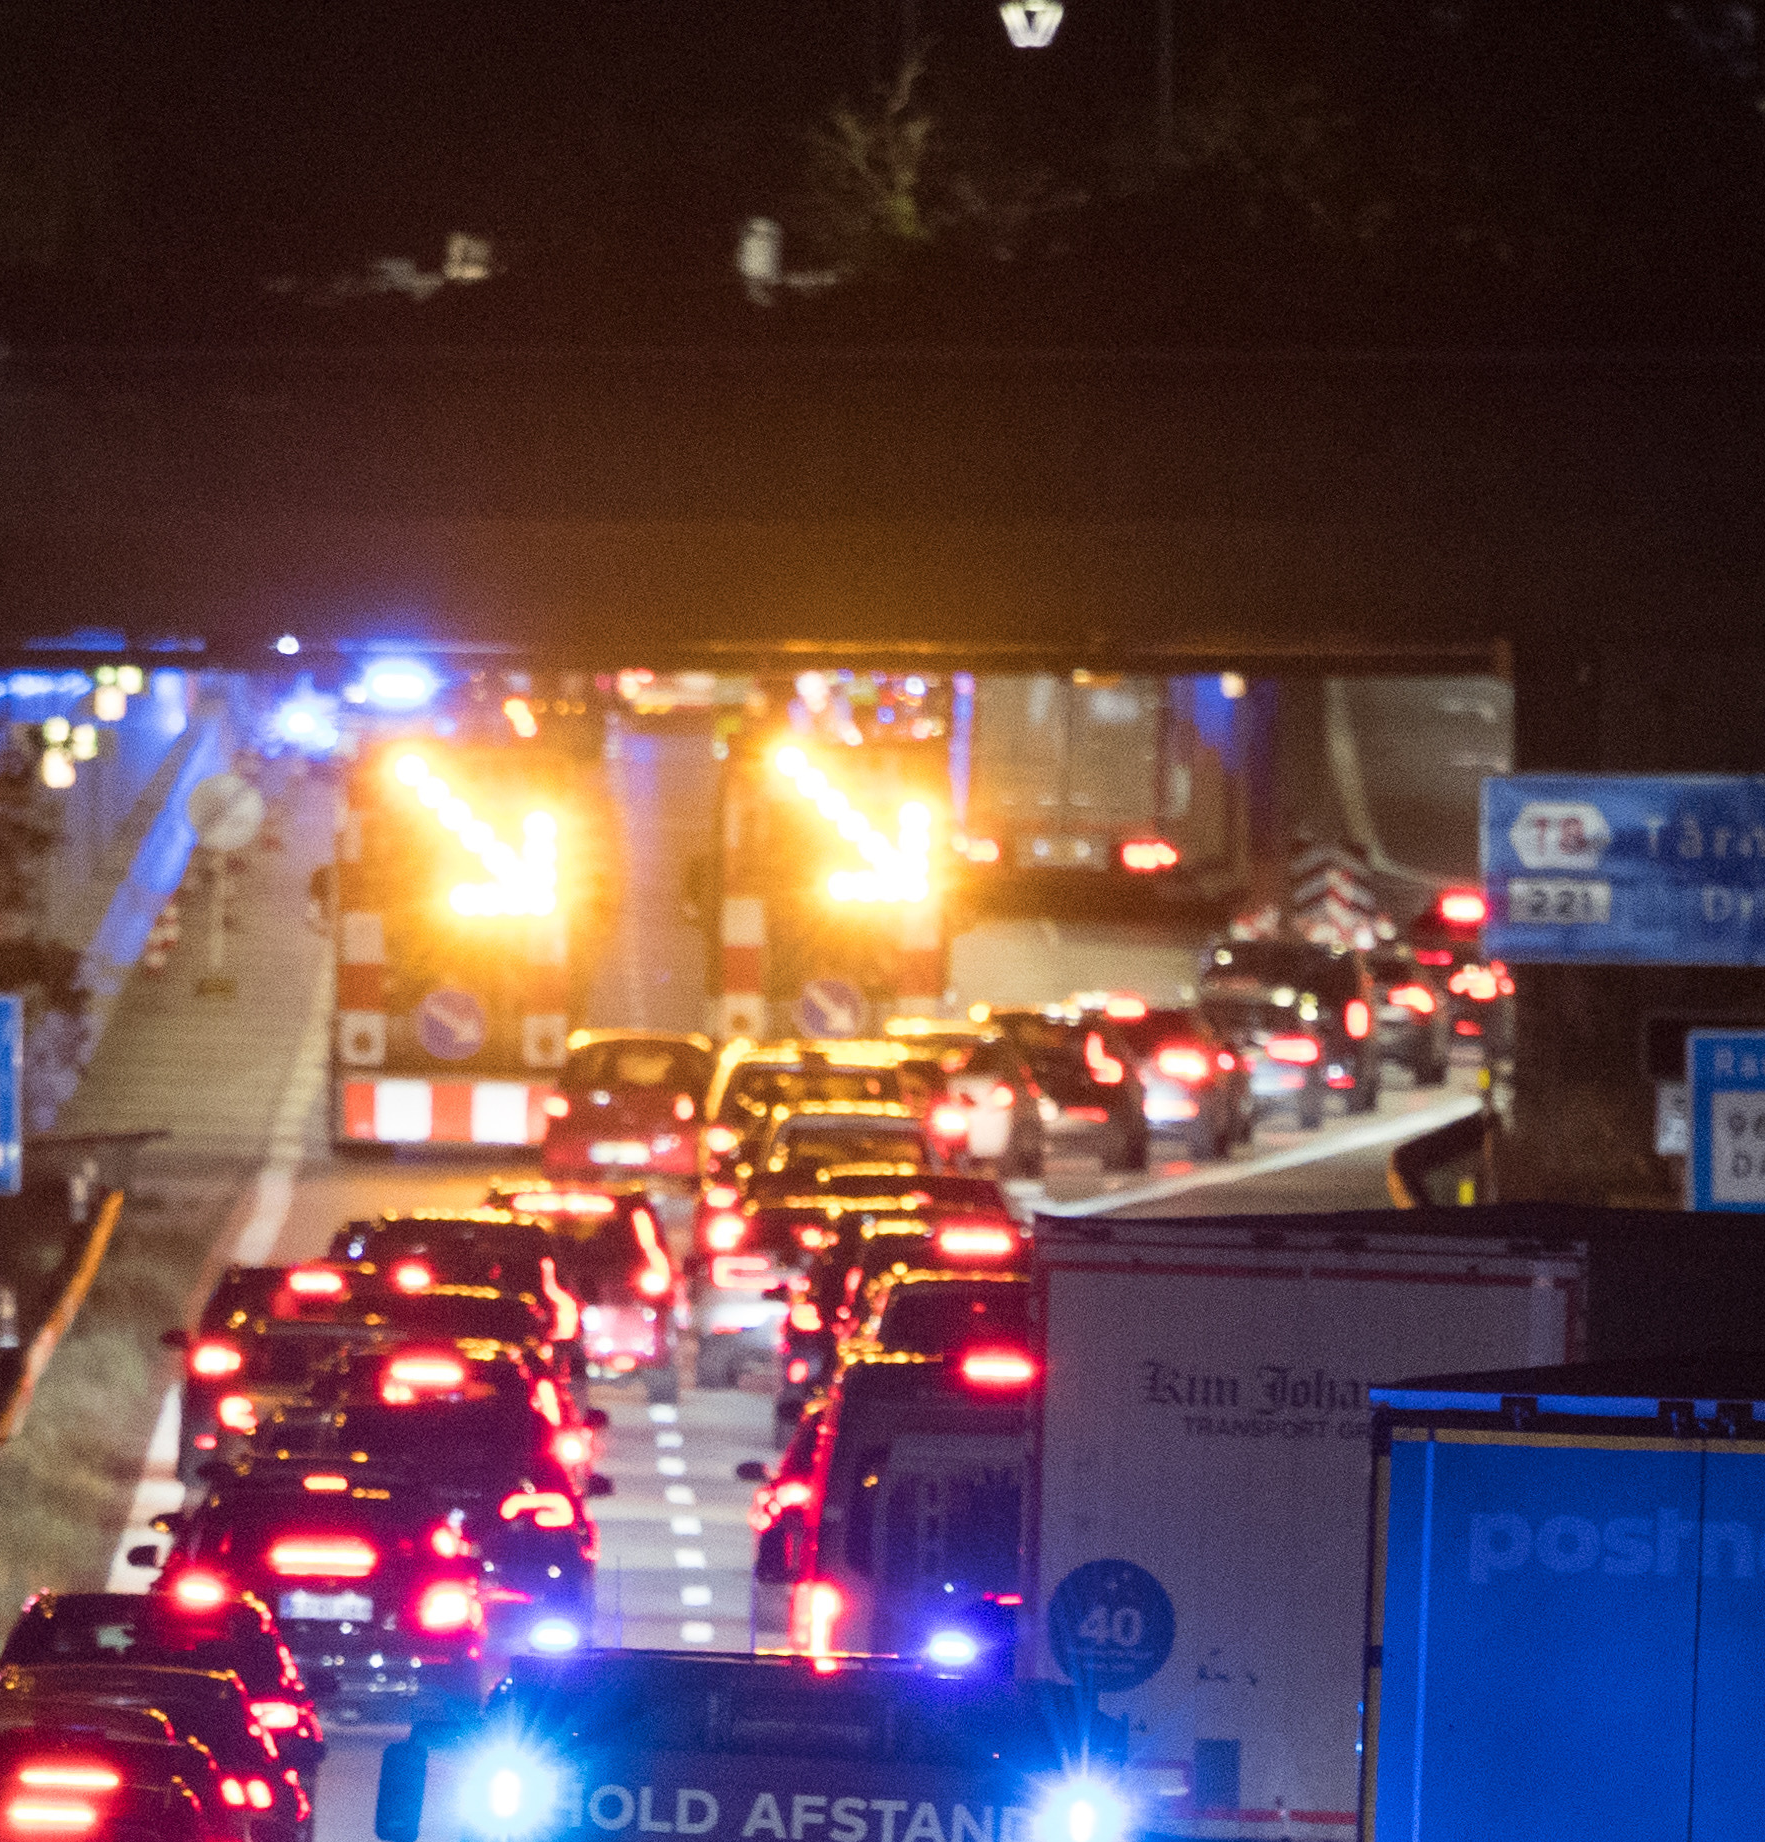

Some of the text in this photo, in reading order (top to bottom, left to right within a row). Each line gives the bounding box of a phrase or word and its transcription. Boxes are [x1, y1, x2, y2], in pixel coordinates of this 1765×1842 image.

[1139, 1360, 1240, 1407] Kim
[1183, 1415, 1329, 1439] TRANSPORT
[1077, 1604, 1143, 1647] 40
